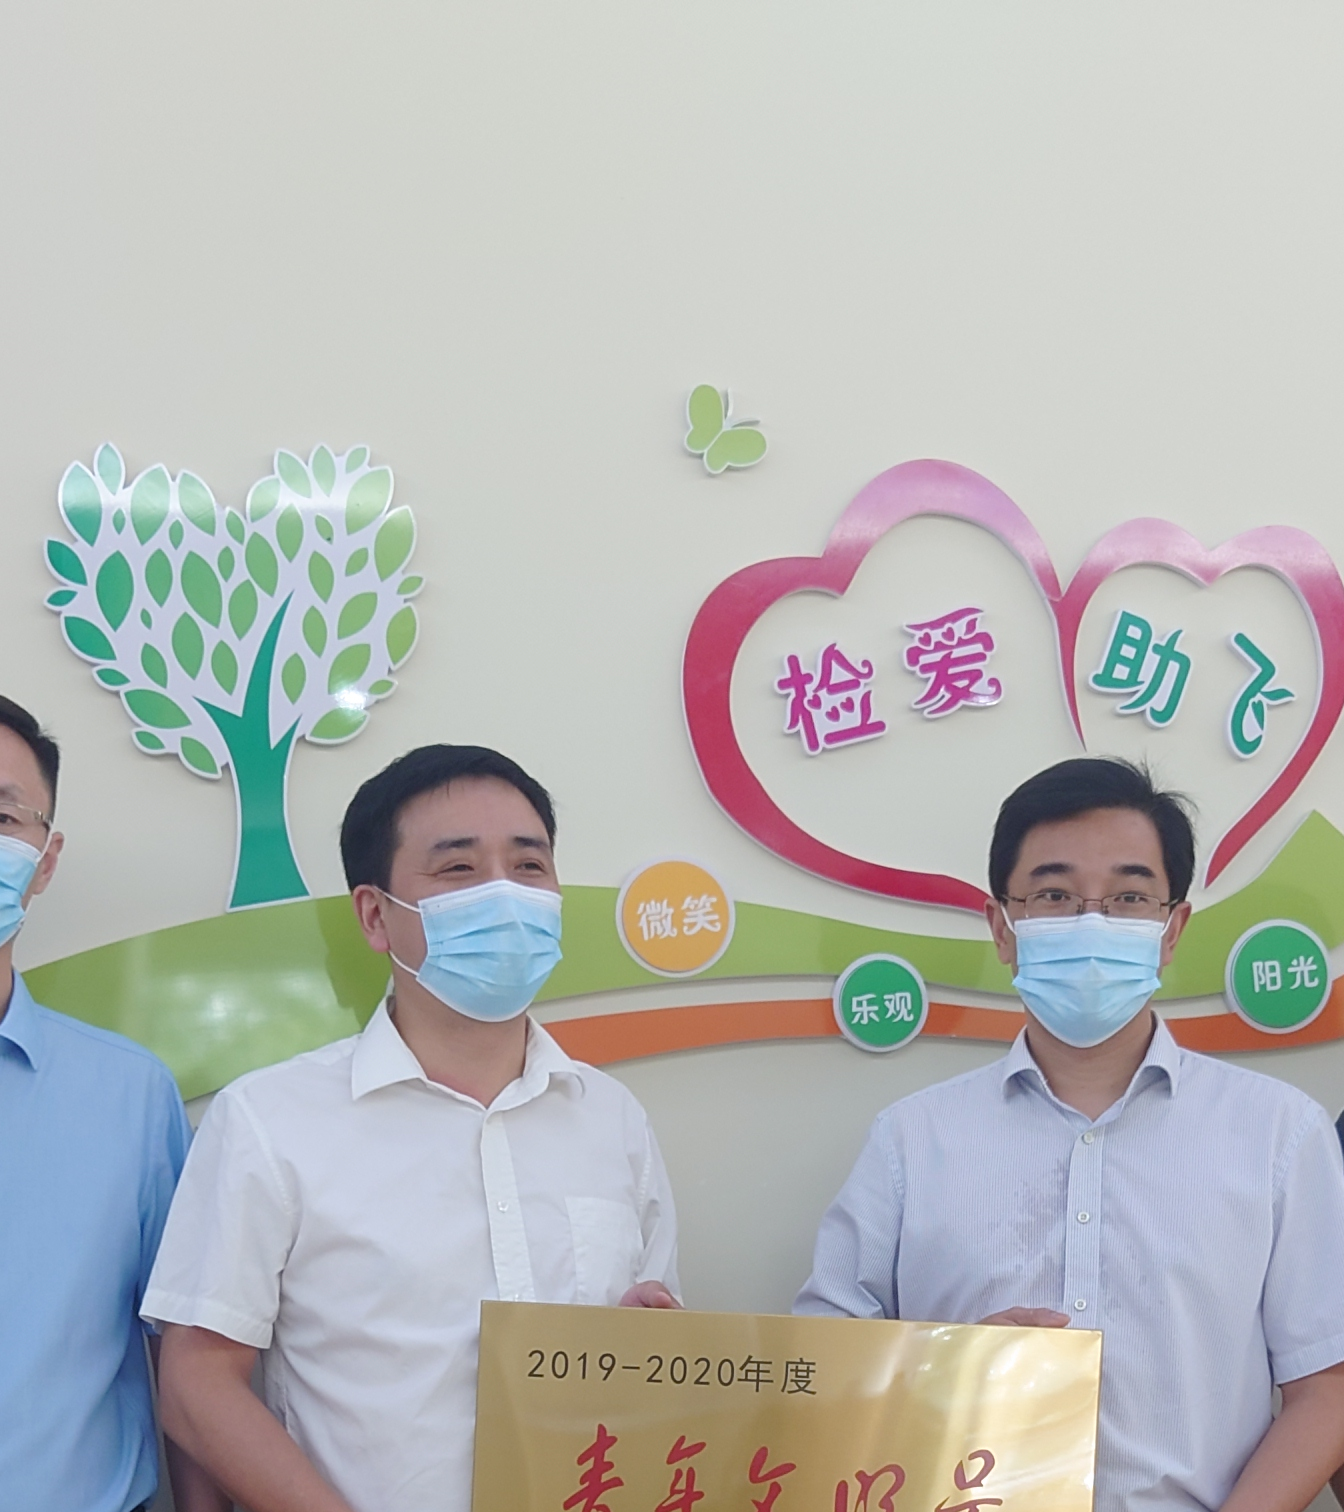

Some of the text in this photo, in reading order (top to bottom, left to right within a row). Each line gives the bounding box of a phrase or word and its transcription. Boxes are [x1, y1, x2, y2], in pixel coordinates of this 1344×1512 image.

[775, 606, 1296, 757] 检爱 助飞
[637, 894, 722, 941] 微笑
[1252, 955, 1320, 993] 阳光
[850, 991, 915, 1025] 乐观
[527, 1349, 818, 1396] 2019-2020年度
